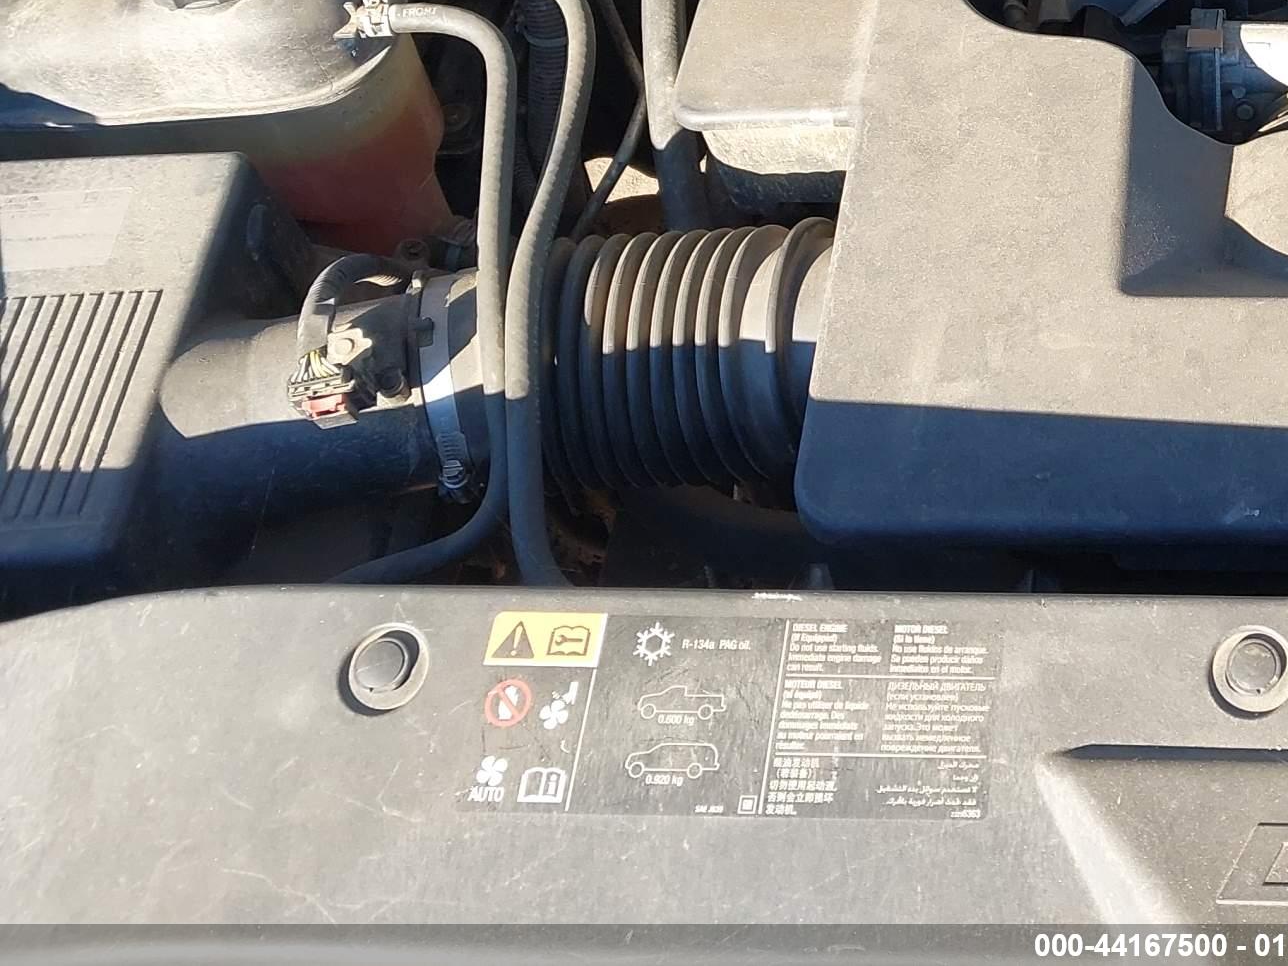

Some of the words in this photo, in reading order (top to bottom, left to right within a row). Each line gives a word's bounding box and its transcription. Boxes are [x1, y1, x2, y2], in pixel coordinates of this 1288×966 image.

[793, 623, 818, 632] DIESEL
[819, 624, 848, 633] ENGINE
[894, 624, 921, 633] MOTOR
[922, 625, 949, 634] DIESEL
[801, 633, 837, 644] Equipped)
[681, 639, 715, 649] R-134a
[719, 639, 737, 650] PAG
[738, 640, 751, 650] oil.
[790, 643, 799, 651] Do
[801, 644, 813, 652] not
[829, 644, 856, 654] starting
[892, 643, 902, 653] No
[943, 645, 953, 653] de
[788, 652, 826, 662] Immediate
[827, 654, 851, 663] engine
[853, 654, 882, 664] damage
[891, 654, 901, 663] Se
[902, 654, 929, 664] pueden
[930, 655, 960, 665] producir
[787, 663, 800, 671] can
[784, 679, 816, 688] MOTEUR
[817, 680, 843, 689] DIESEL
[887, 680, 938, 691] ДИЗЕЛЬНЫЙ
[940, 682, 986, 692] ДВИГАТЕЛЬ
[886, 702, 897, 711] Не
[683, 714, 695, 726] kg
[941, 715, 985, 723] холодного
[672, 775, 684, 786] kg
[467, 785, 505, 803] AUTO
